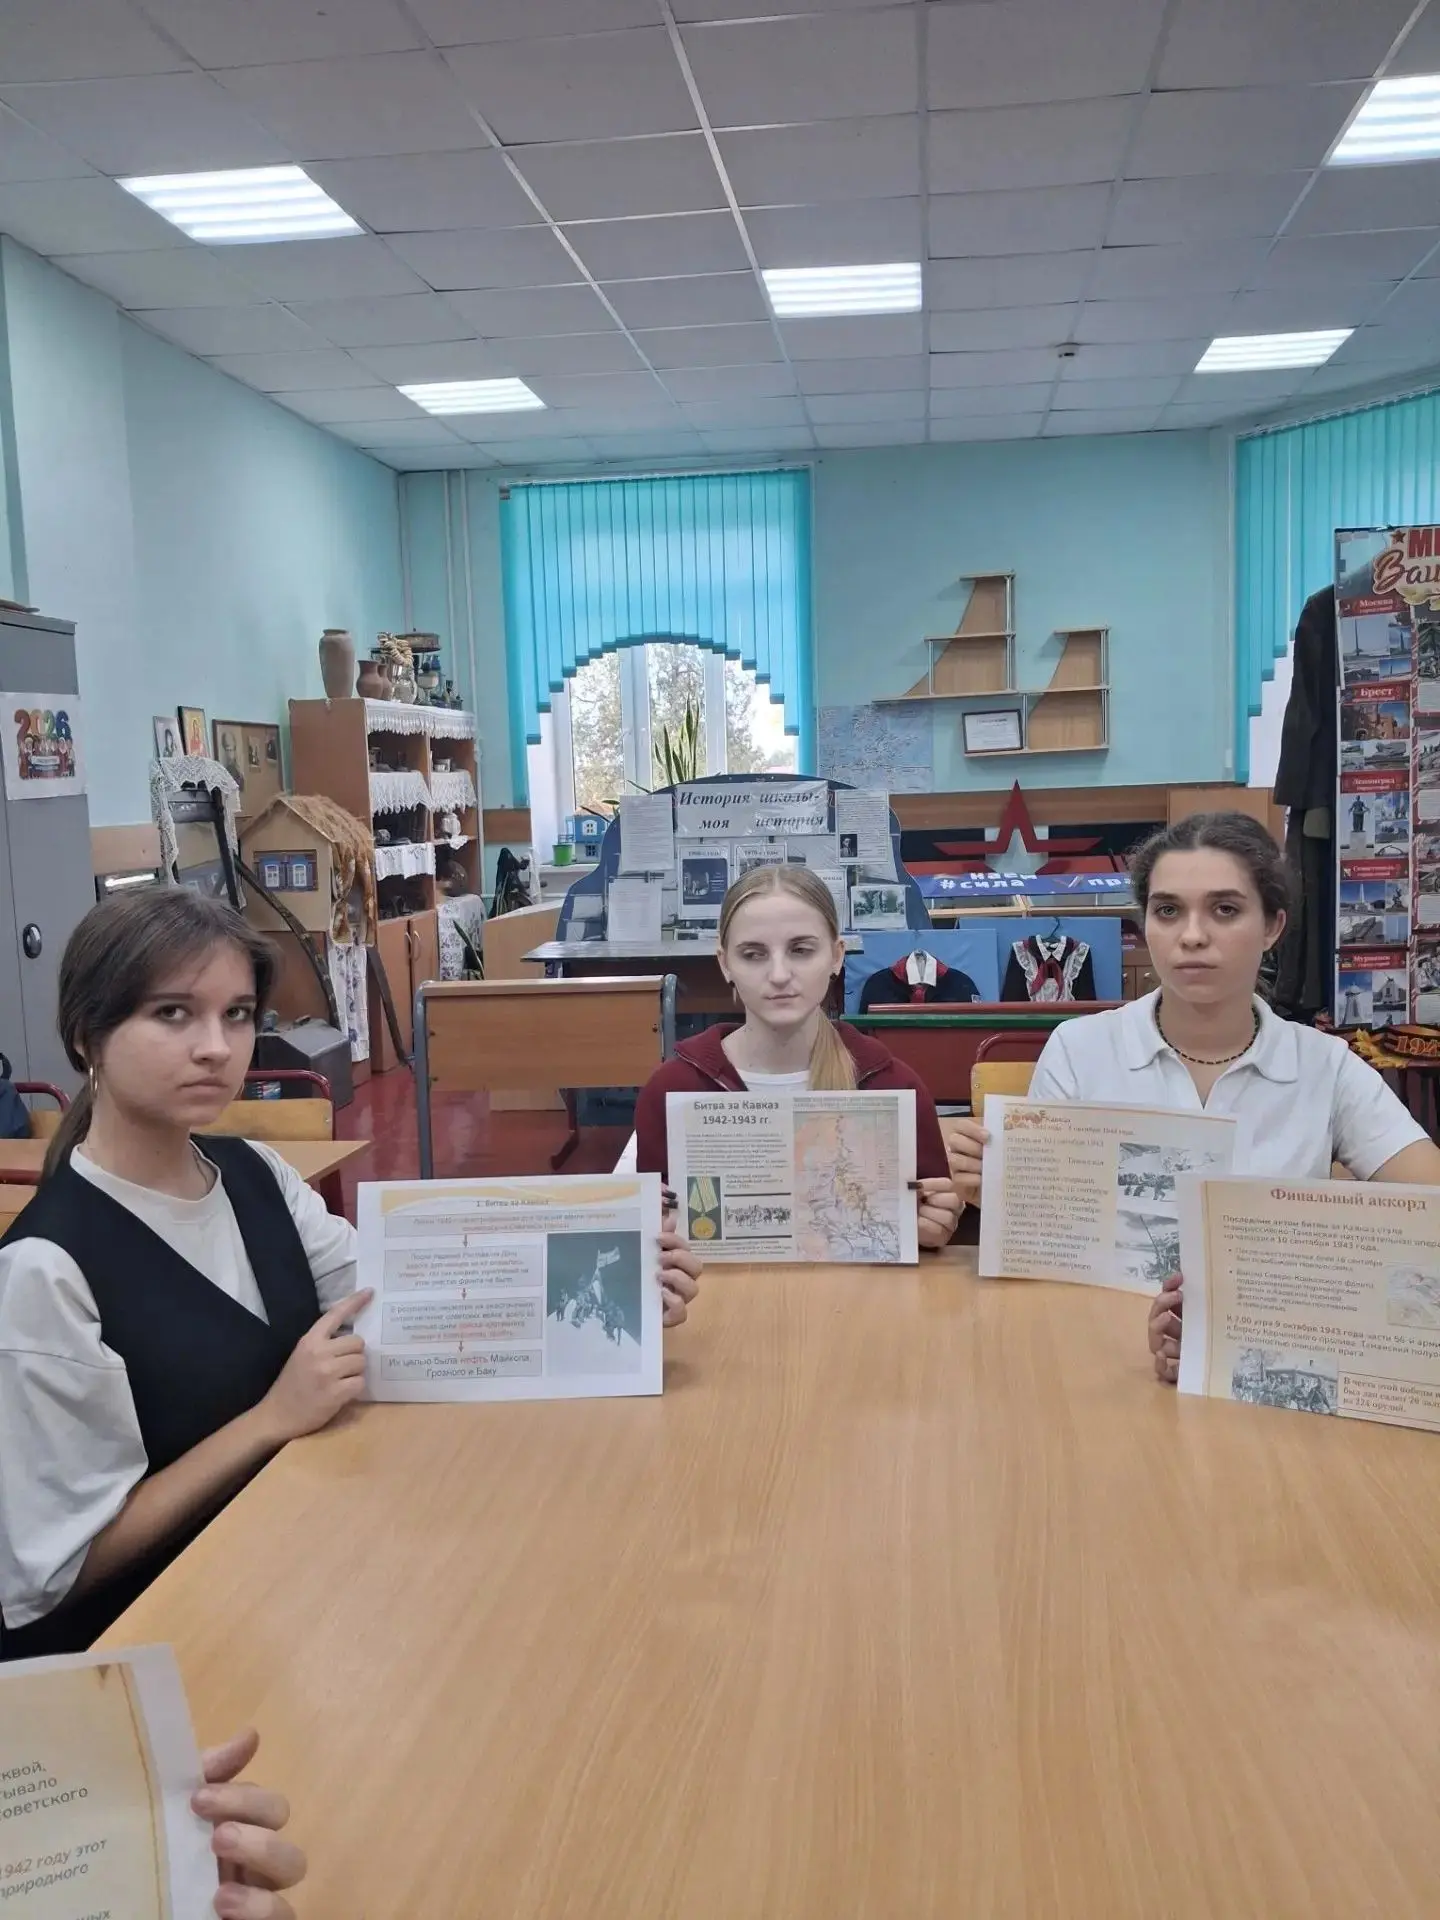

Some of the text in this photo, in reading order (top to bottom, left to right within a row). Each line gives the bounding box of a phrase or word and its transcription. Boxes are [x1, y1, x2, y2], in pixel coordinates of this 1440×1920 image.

[1408, 528, 1440, 557] М
[1360, 688, 1393, 697] Брест
[14, 709, 73, 748] 2026
[680, 792, 819, 807] История школы-
[699, 816, 825, 829] моя история
[940, 879, 1025, 889] #сила
[694, 1100, 779, 1110] Битва за Кавказ
[703, 1115, 771, 1124] 1942-1943 гг.
[1270, 1188, 1426, 1212] Финальный аккорд
[1278, 1236, 1287, 1244] 10
[1333, 1240, 1353, 1250] 1943
[402, 1359, 431, 1367] целью
[434, 1356, 457, 1365] была
[426, 1368, 466, 1379] Грозного
[476, 1367, 497, 1376] Баку
[36, 1850, 71, 1869] году
[76, 1839, 107, 1858] этот
